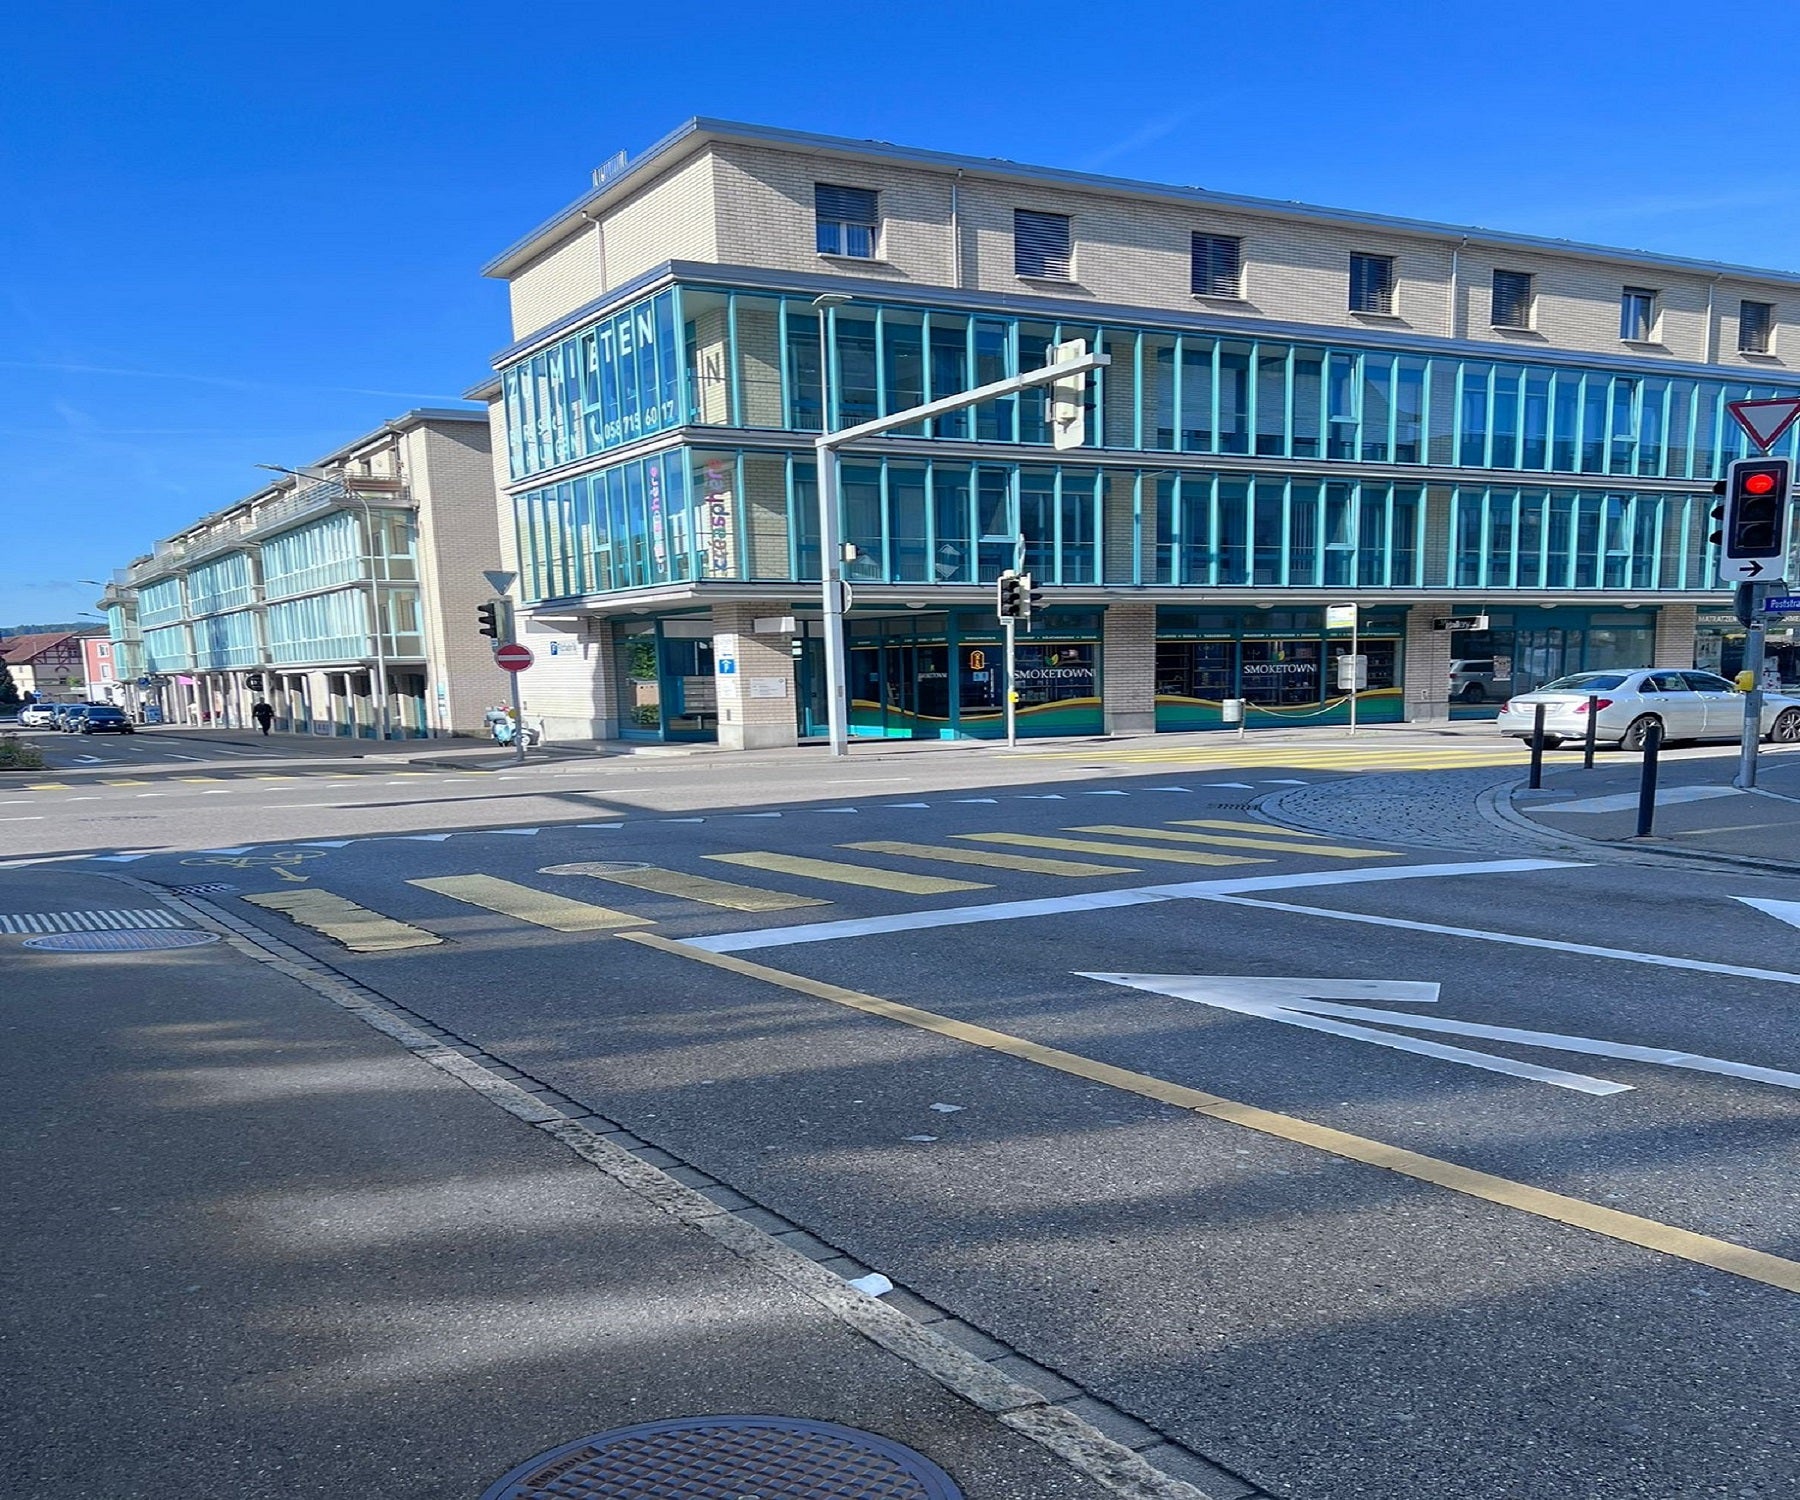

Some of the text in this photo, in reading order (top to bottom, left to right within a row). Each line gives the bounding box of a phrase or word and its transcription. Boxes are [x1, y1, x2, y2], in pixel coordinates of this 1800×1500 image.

[604, 399, 674, 440] 058 715 60 17
[1013, 668, 1094, 679] SMOKETOWN
[1243, 663, 1315, 674] SMOKETOWN
